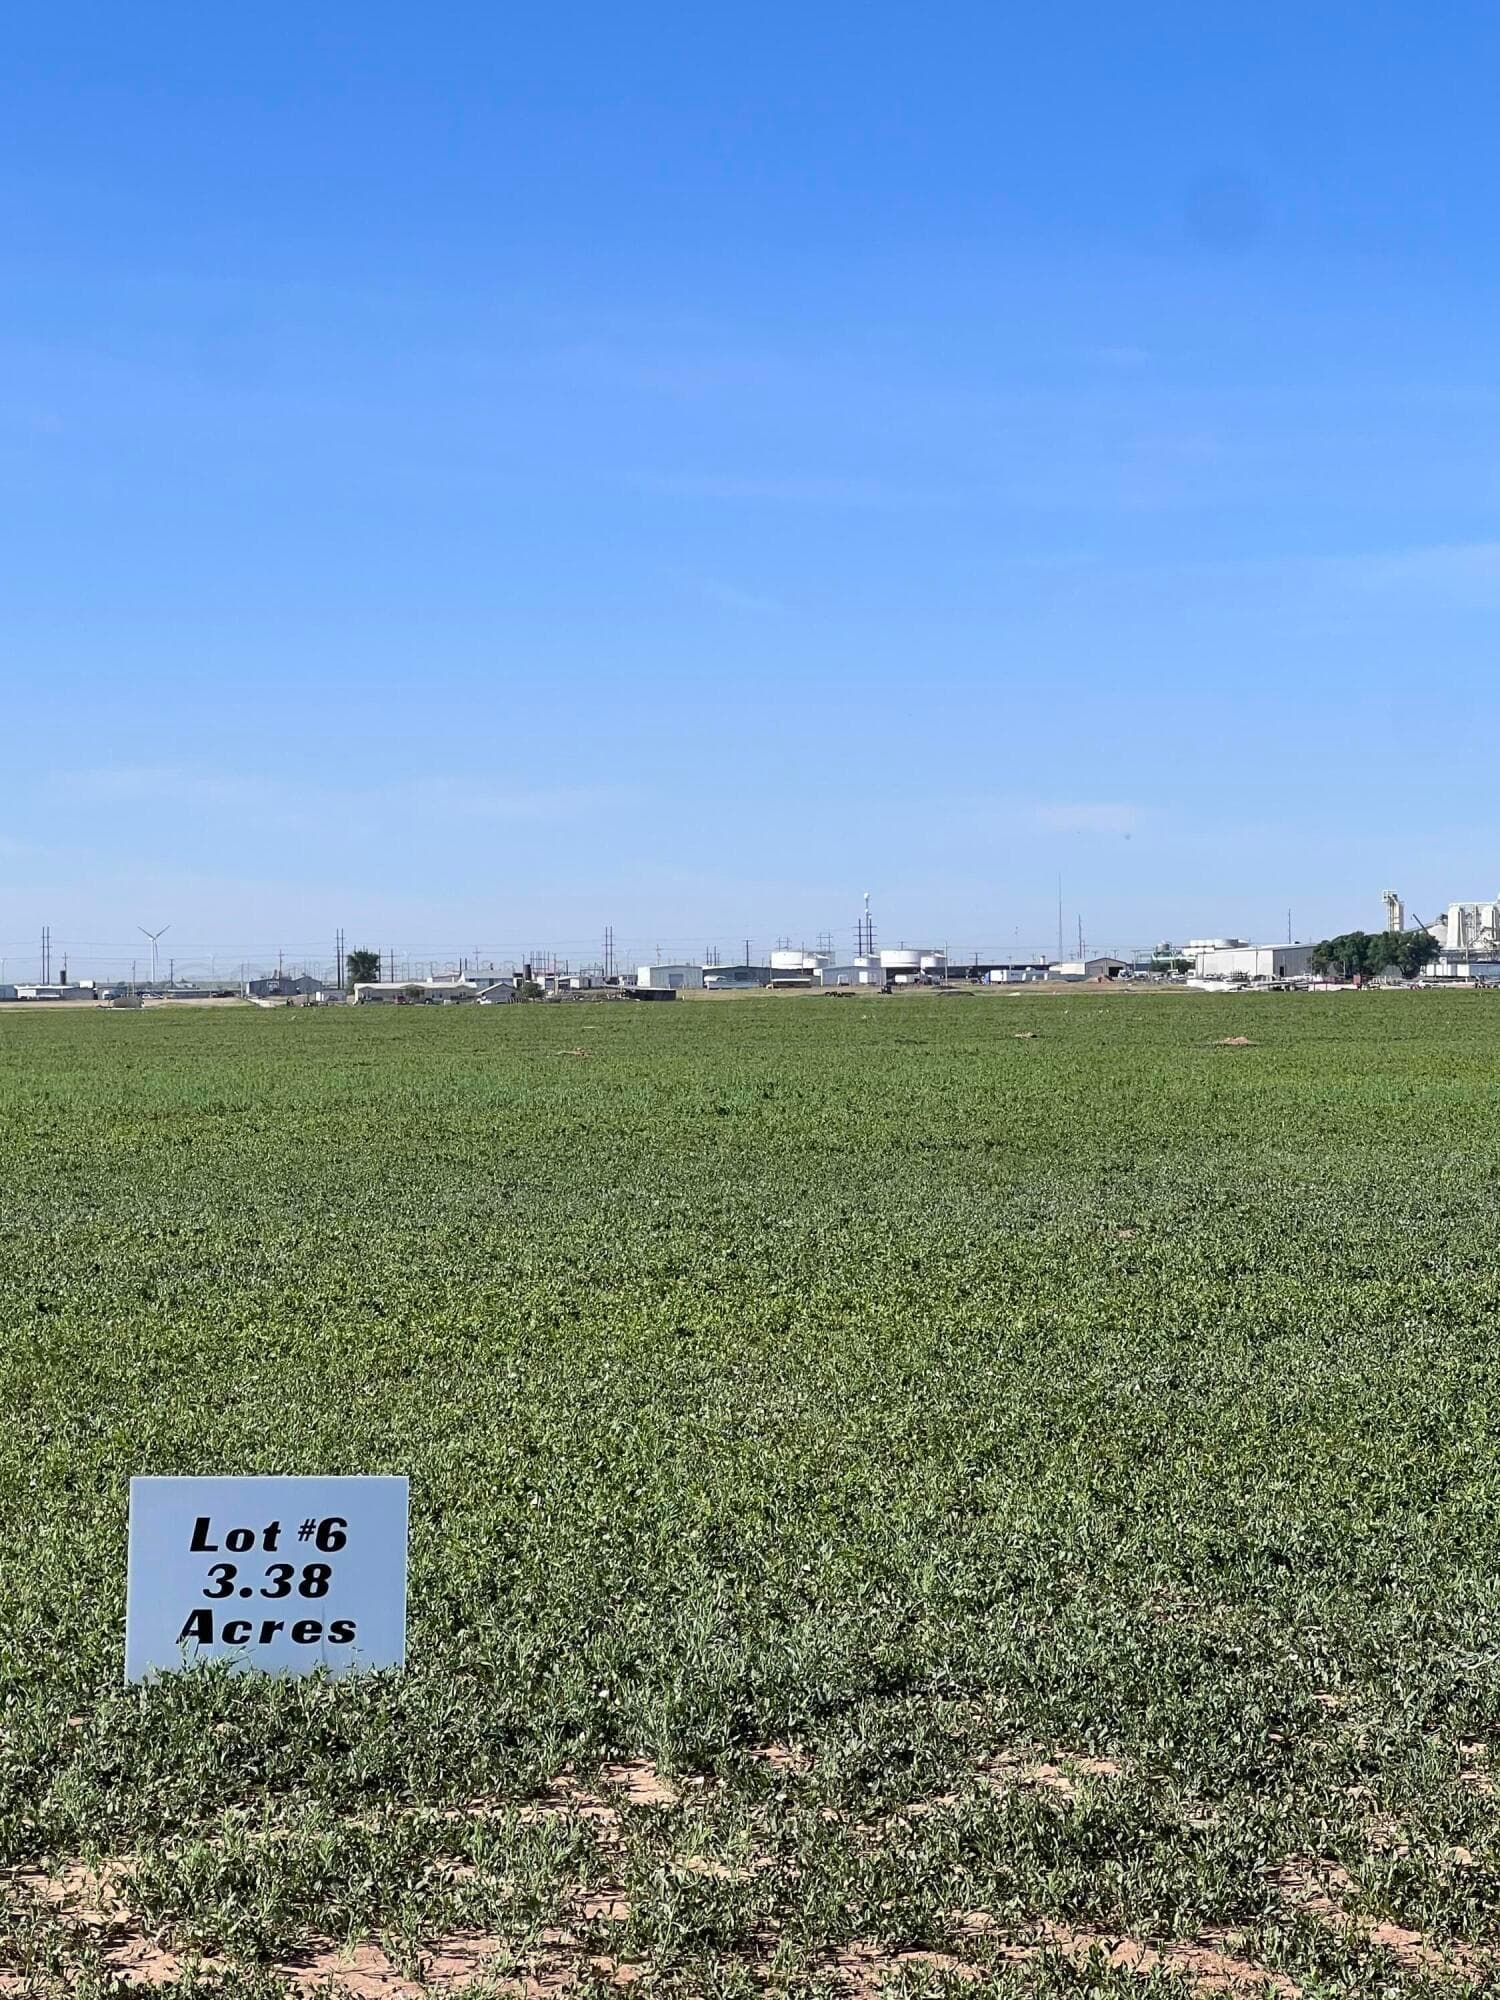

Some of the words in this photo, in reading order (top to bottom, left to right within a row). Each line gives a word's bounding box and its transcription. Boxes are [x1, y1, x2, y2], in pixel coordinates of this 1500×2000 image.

[189, 1517, 282, 1552] Lot
[297, 1517, 348, 1553] #6
[202, 1563, 333, 1599] 3.38
[176, 1609, 357, 1645] Acres
